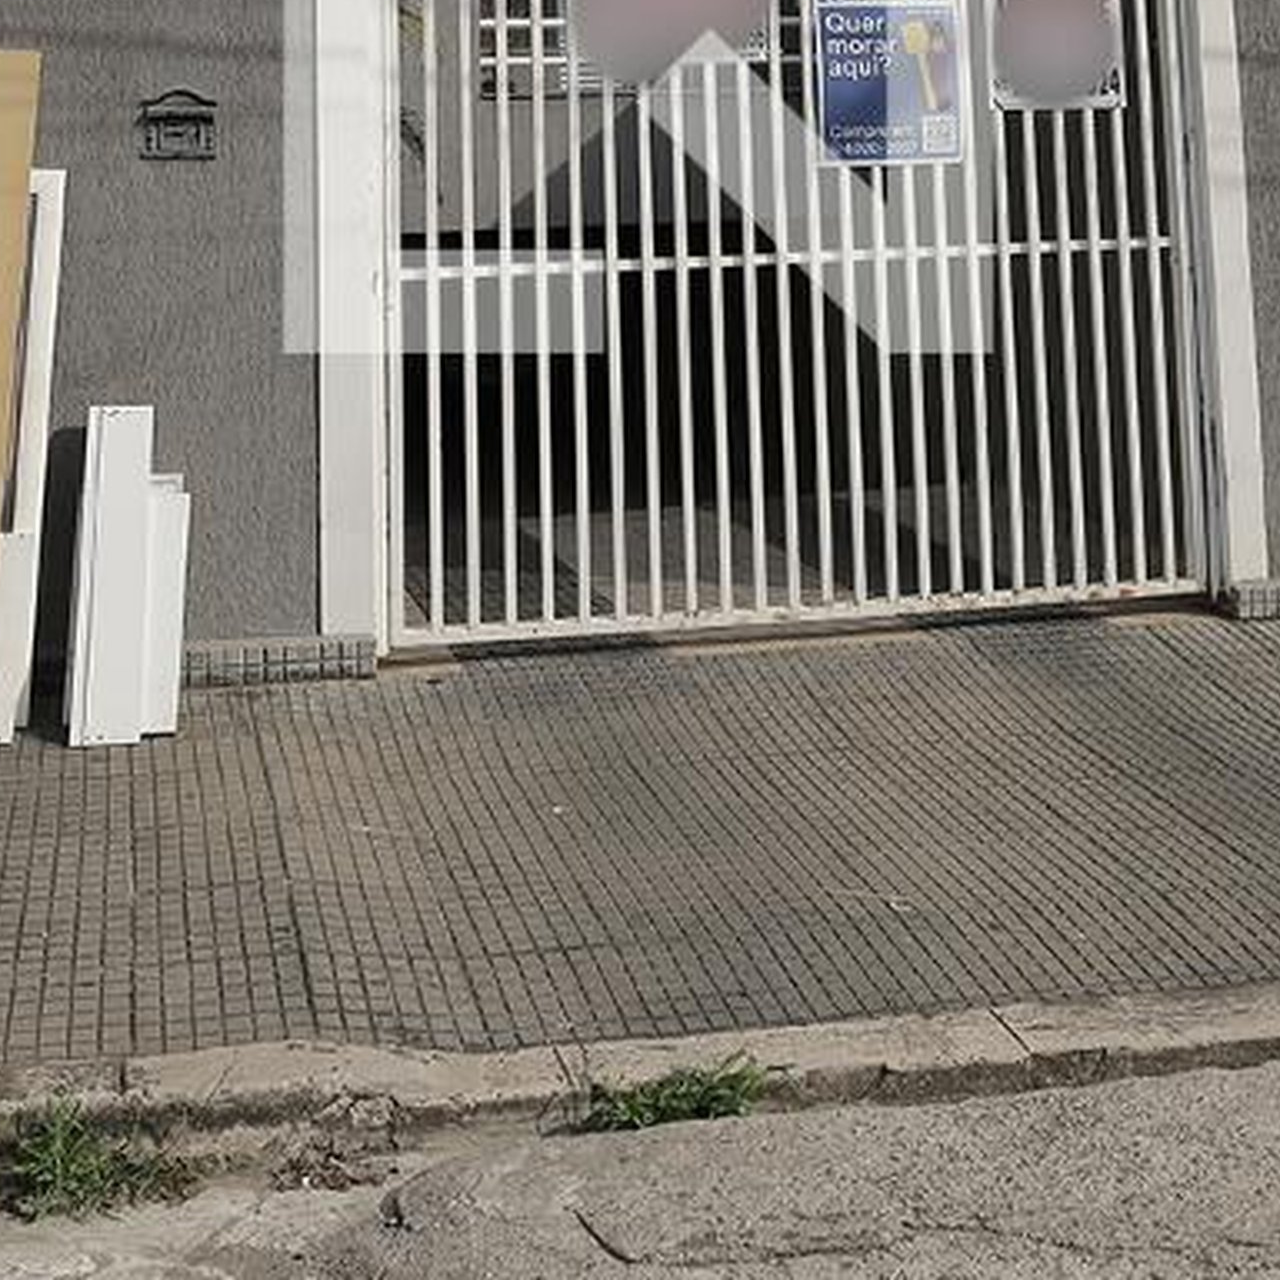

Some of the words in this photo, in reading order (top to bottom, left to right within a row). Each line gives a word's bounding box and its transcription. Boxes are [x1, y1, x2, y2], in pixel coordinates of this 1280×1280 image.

[825, 12, 885, 34] Quer
[826, 37, 902, 55] morar
[828, 54, 892, 80] aqui?
